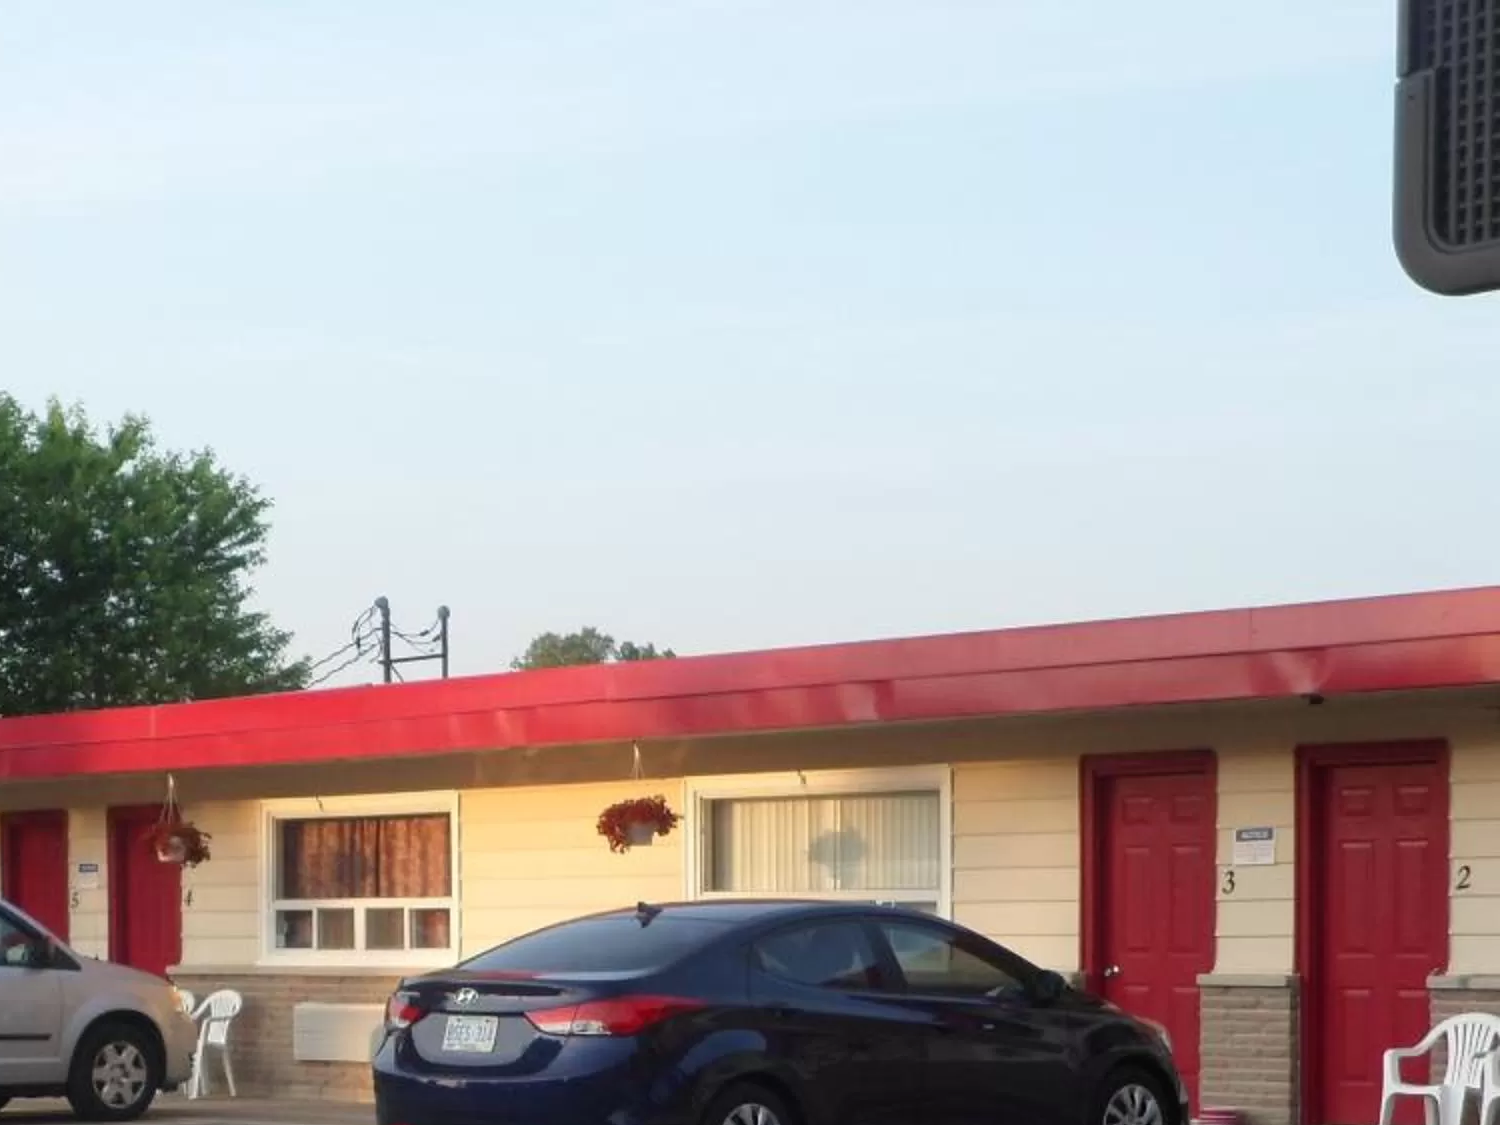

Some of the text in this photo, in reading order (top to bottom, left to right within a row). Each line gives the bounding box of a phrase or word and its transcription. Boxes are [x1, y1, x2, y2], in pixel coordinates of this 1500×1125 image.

[1222, 870, 1235, 895] 3
[1456, 865, 1471, 891] 2
[70, 891, 80, 909] 5
